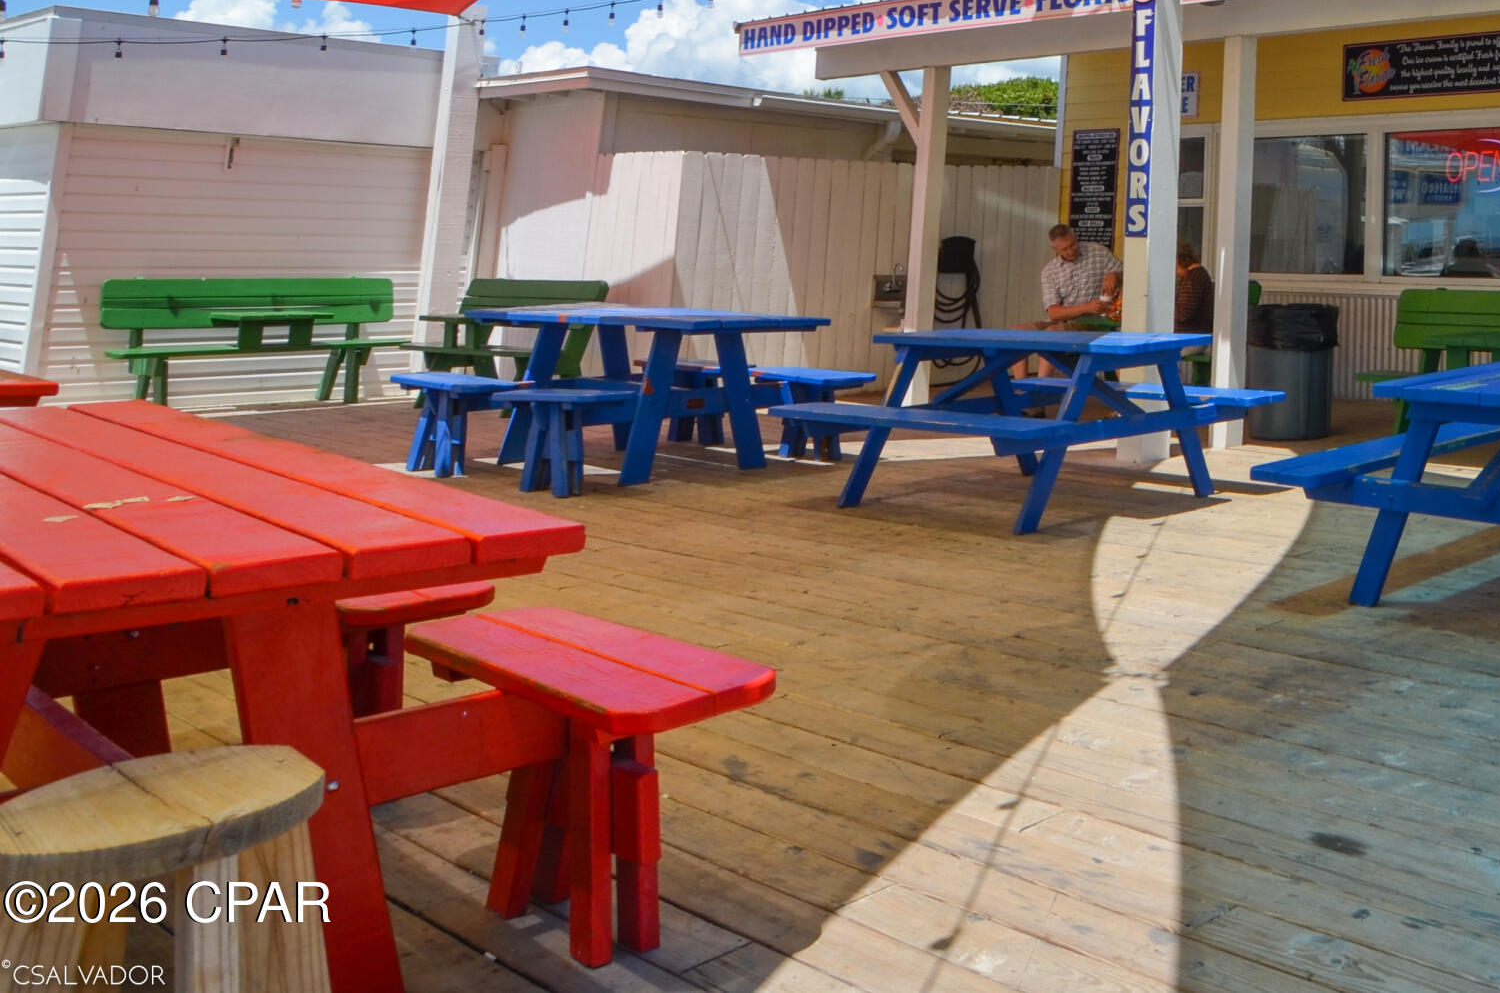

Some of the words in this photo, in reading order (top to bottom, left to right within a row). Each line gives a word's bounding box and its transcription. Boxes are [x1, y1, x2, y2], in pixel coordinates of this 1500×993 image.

[743, 22, 796, 51] HAND
[802, 12, 875, 42] DIPPED
[885, 2, 940, 30] SOFT
[1128, 9, 1154, 233] FLAVORS
